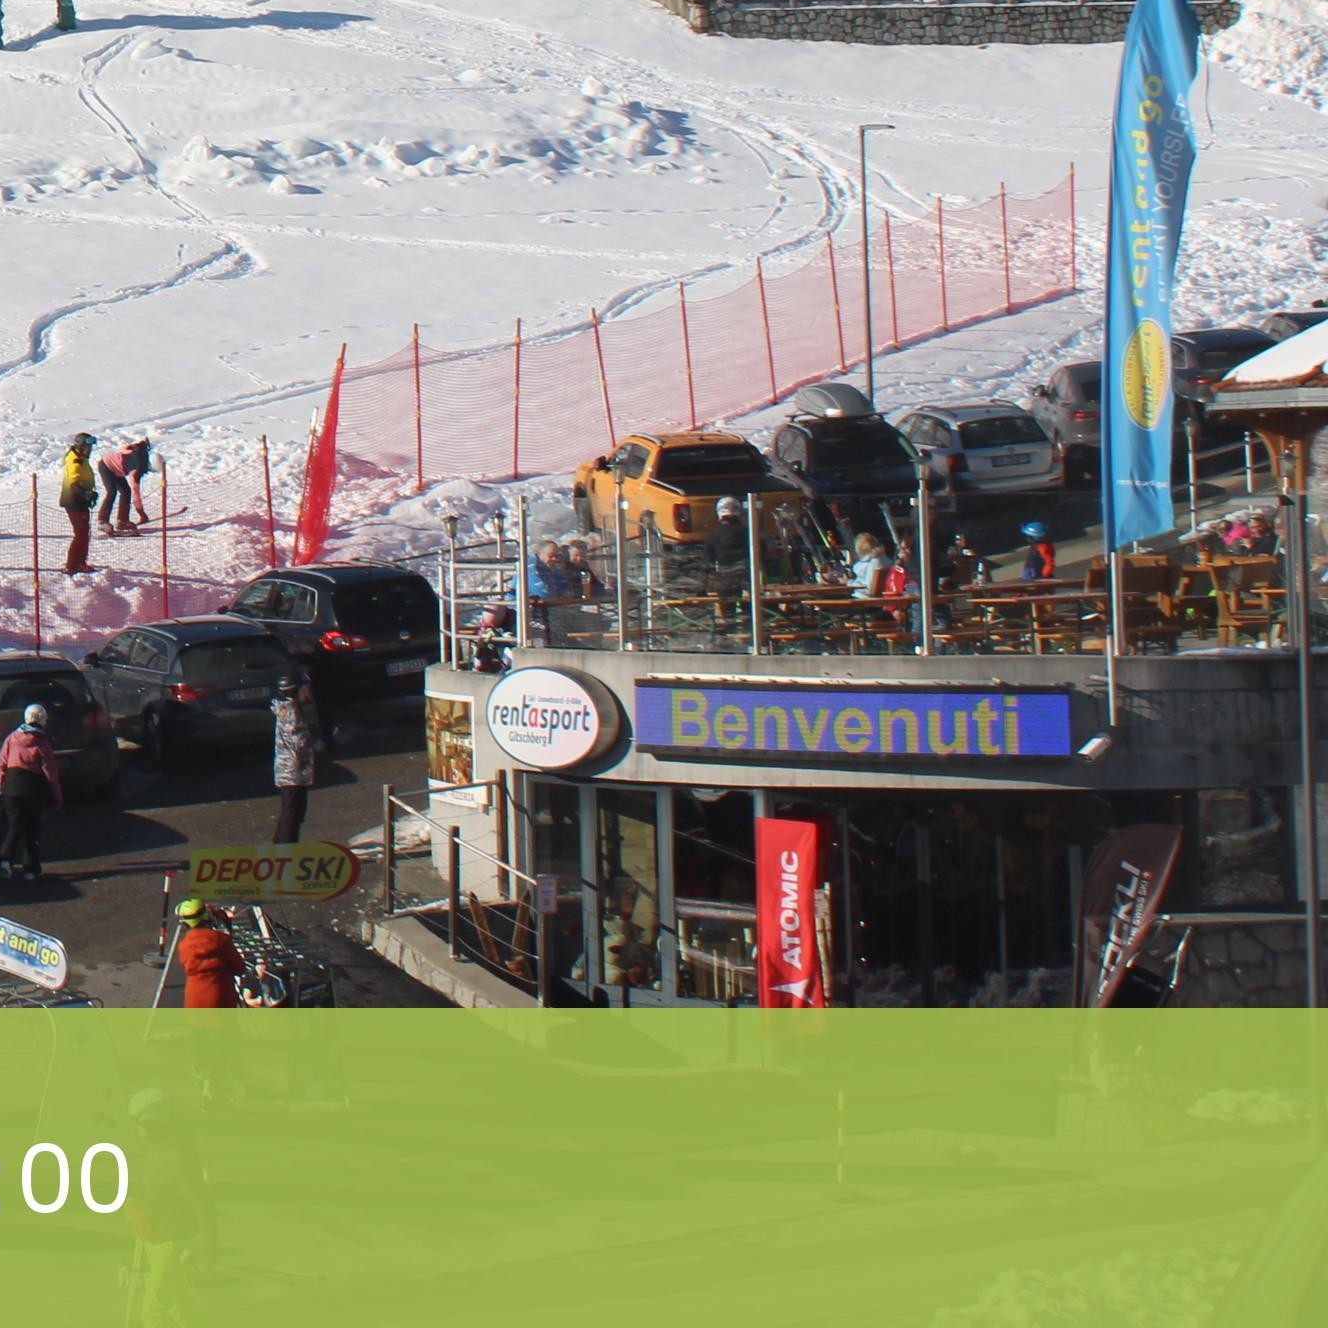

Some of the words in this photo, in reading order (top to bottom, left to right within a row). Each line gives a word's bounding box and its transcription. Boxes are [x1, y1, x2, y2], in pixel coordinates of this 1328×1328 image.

[1137, 74, 1163, 126] go
[1130, 219, 1150, 307] rent
[491, 693, 591, 745] rentasport
[508, 730, 548, 747] Gitschberg
[670, 688, 1021, 755] Benvenuti
[195, 857, 293, 883] DEPOT
[295, 855, 347, 881] SKI
[779, 849, 803, 972] ATOMIC
[8, 933, 39, 957] and
[39, 947, 60, 967] go
